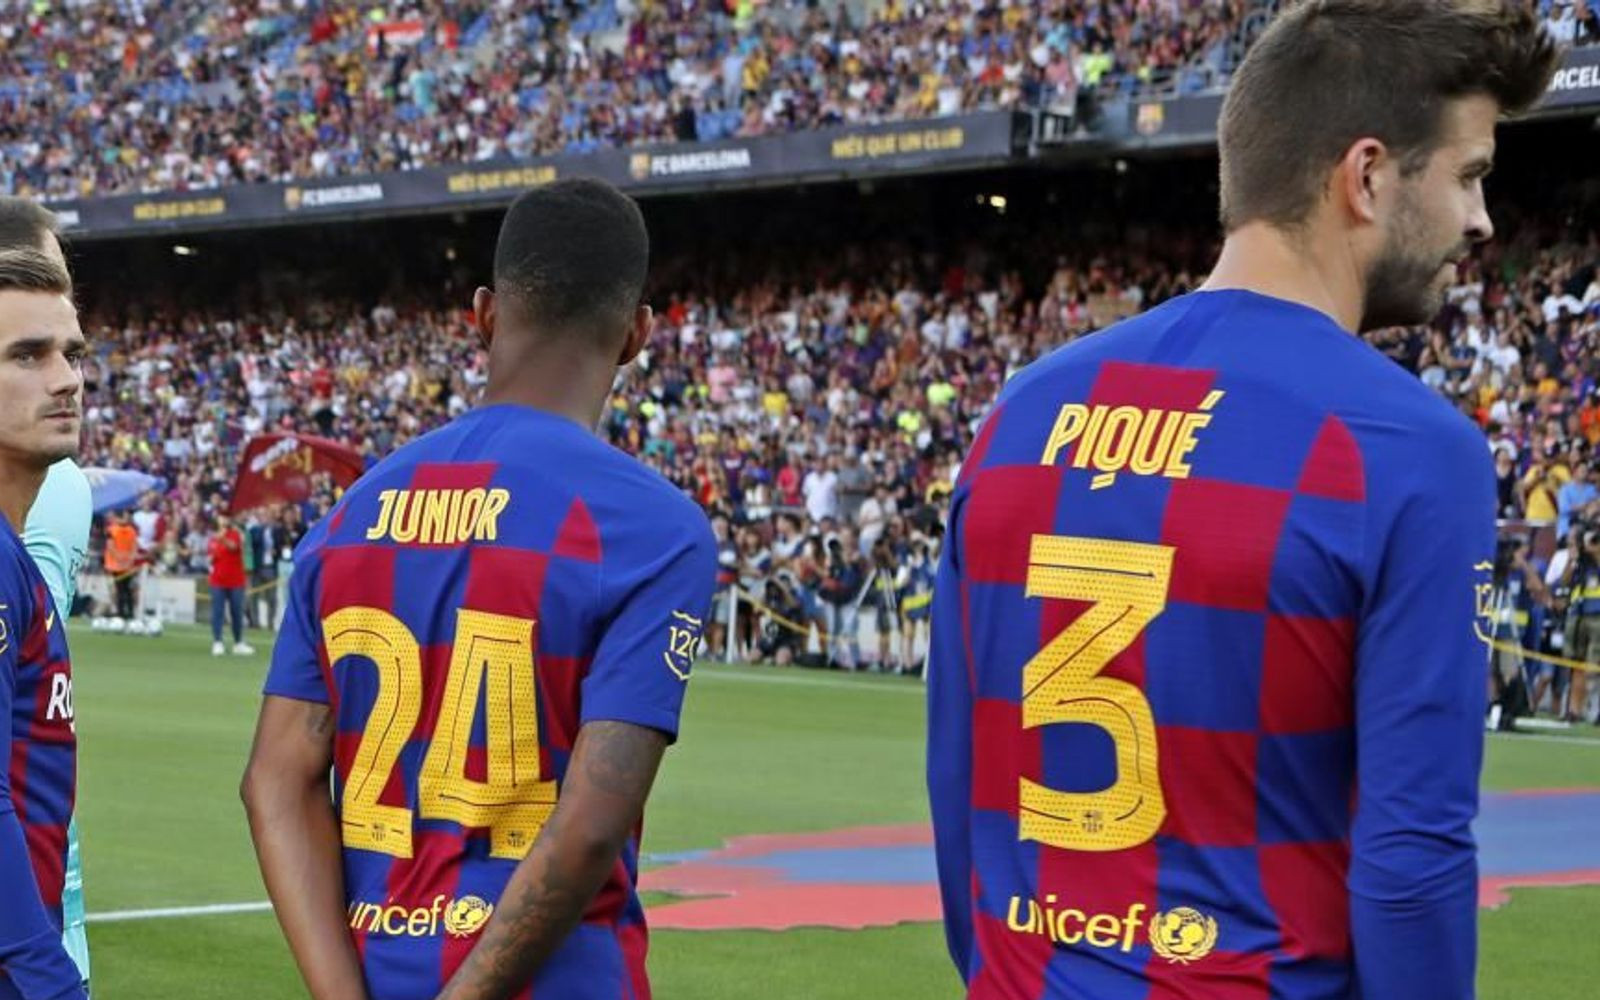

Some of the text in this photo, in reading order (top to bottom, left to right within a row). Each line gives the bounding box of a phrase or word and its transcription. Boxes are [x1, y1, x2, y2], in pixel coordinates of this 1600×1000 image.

[1041, 390, 1225, 490] PIQUÉ
[366, 488, 509, 543] JUNIOR
[321, 605, 560, 860] 24
[1018, 534, 1176, 851] 3
[1007, 895, 1145, 953] unicef
